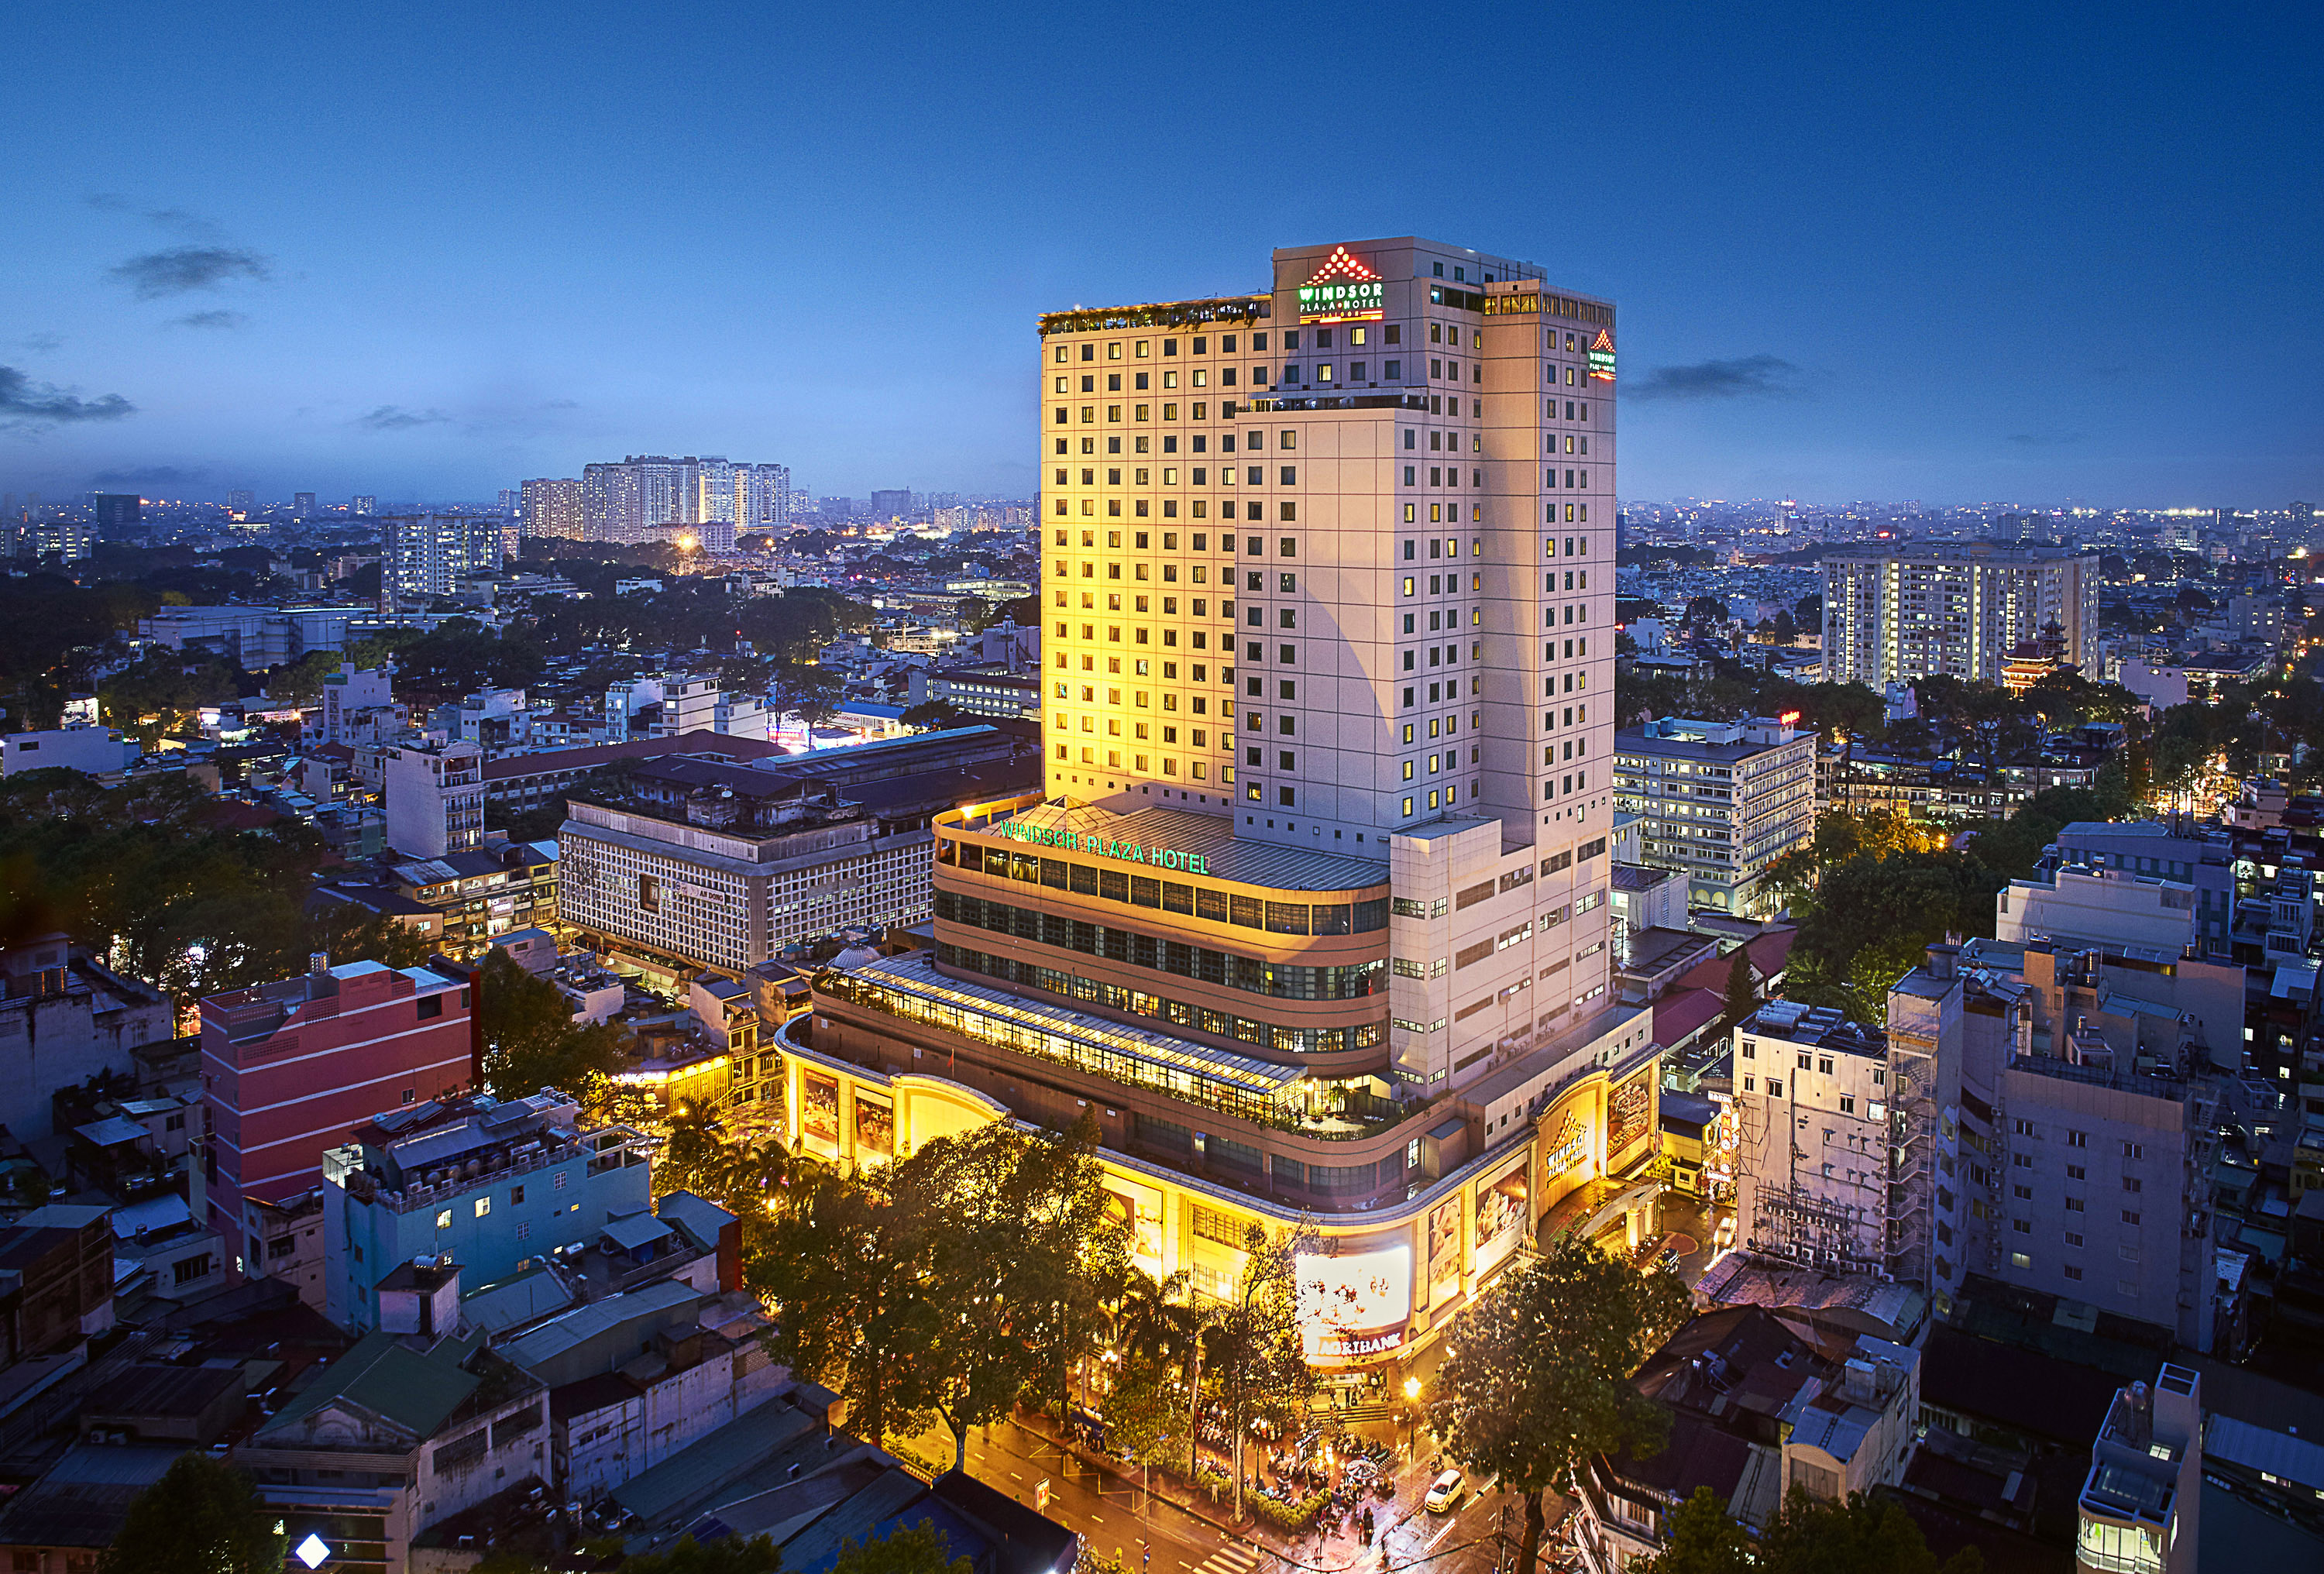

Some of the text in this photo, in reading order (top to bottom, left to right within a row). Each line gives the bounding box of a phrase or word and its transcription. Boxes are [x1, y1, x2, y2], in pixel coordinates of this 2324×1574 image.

[1299, 284, 1382, 301] WINDSOR
[1344, 298, 1382, 309] HOTEL
[999, 820, 1209, 875] WINDSOR PLAZA HOTEL
